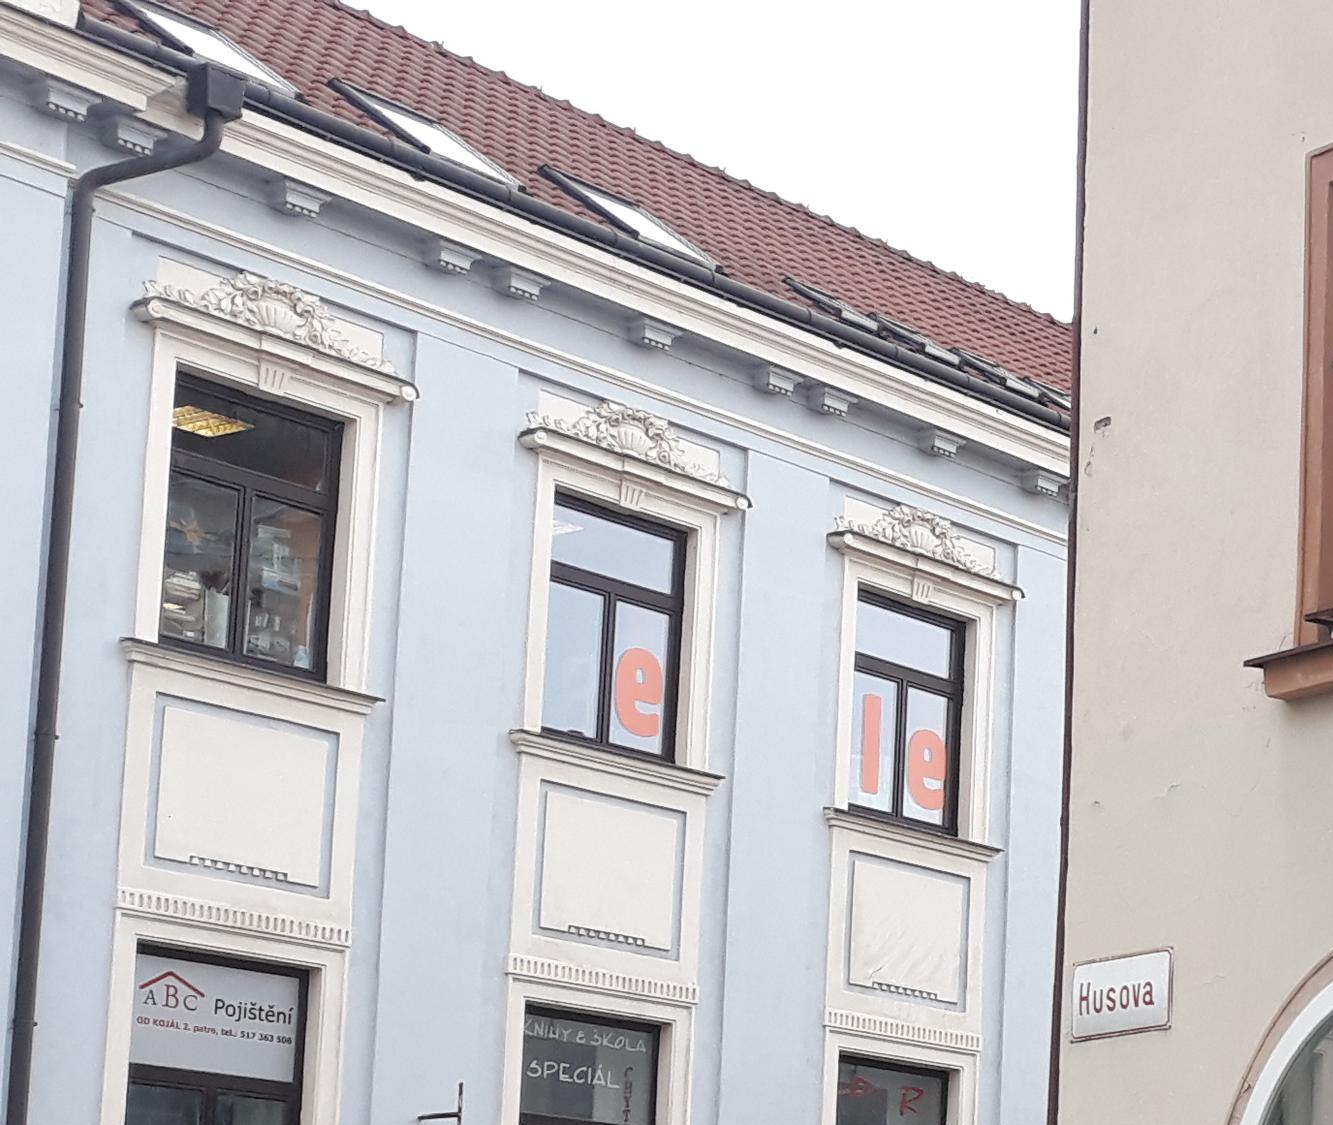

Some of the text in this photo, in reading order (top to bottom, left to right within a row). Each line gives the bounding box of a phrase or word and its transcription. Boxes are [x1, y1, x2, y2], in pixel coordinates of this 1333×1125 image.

[143, 983, 199, 1012] ABC
[214, 998, 295, 1025] Pojištění
[1079, 981, 1155, 1016] Husova
[526, 1060, 621, 1089] SPECIÁL
